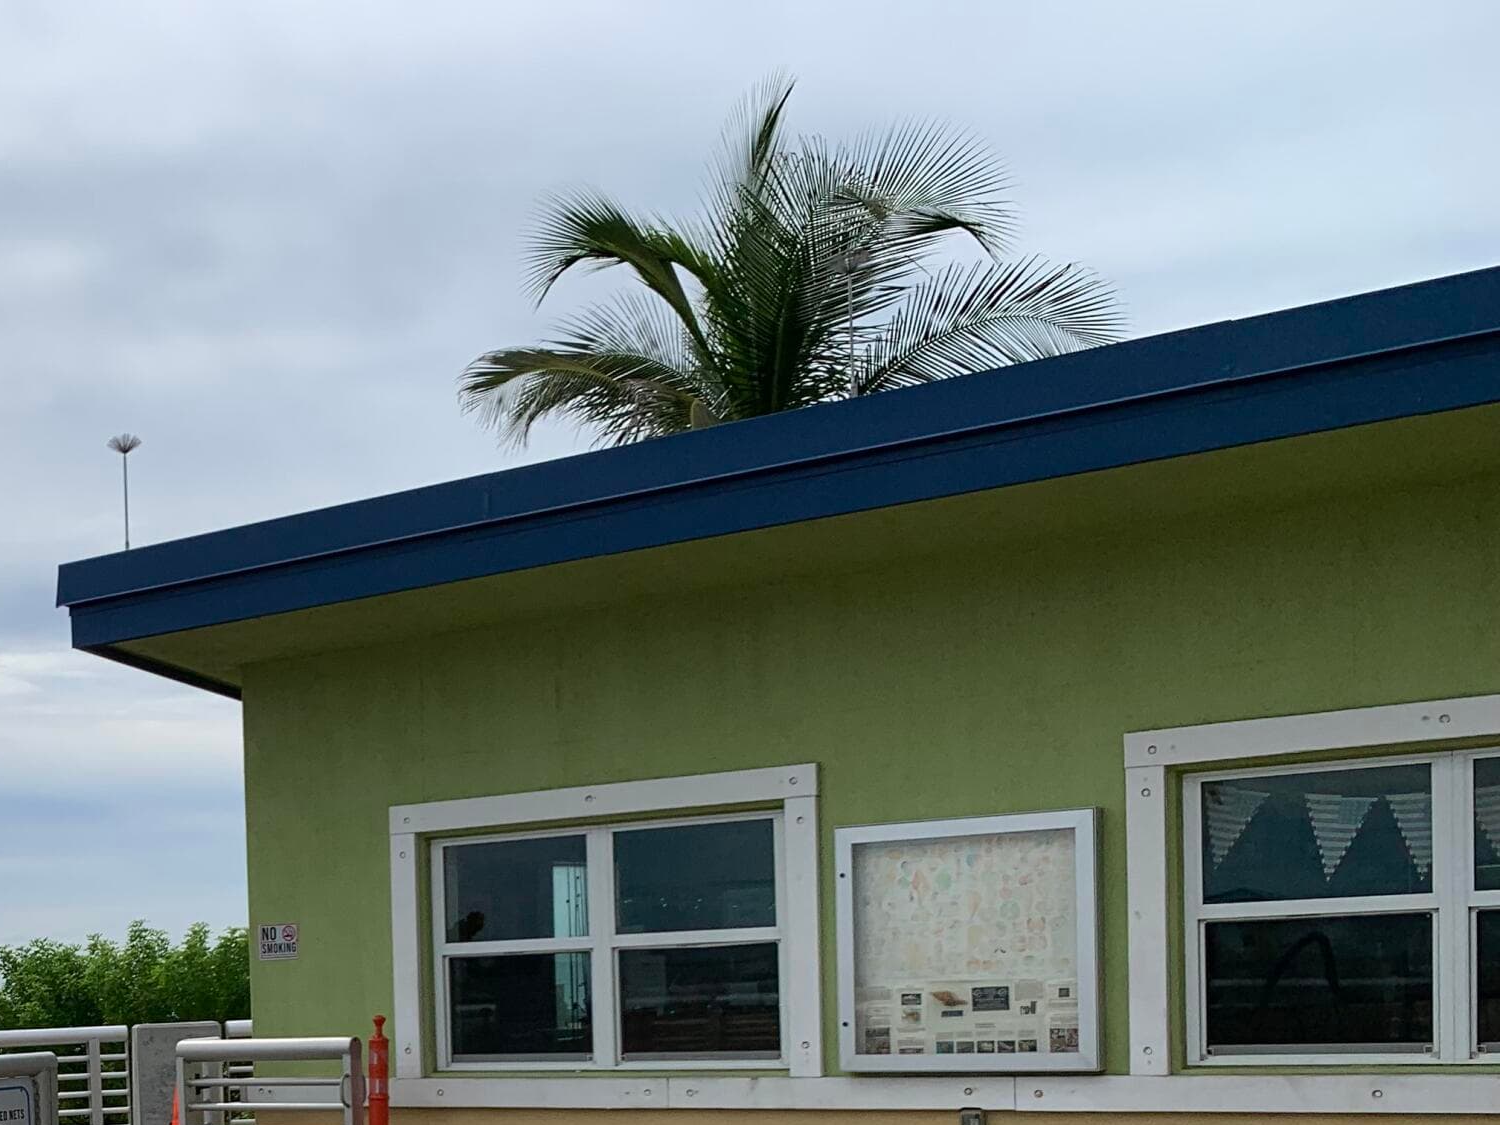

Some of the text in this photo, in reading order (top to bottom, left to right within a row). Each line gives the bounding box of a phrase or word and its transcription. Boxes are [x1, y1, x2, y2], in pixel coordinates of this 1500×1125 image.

[262, 926, 277, 941] NO
[262, 942, 297, 954] SMOKING
[9, 1109, 25, 1120] NETS
